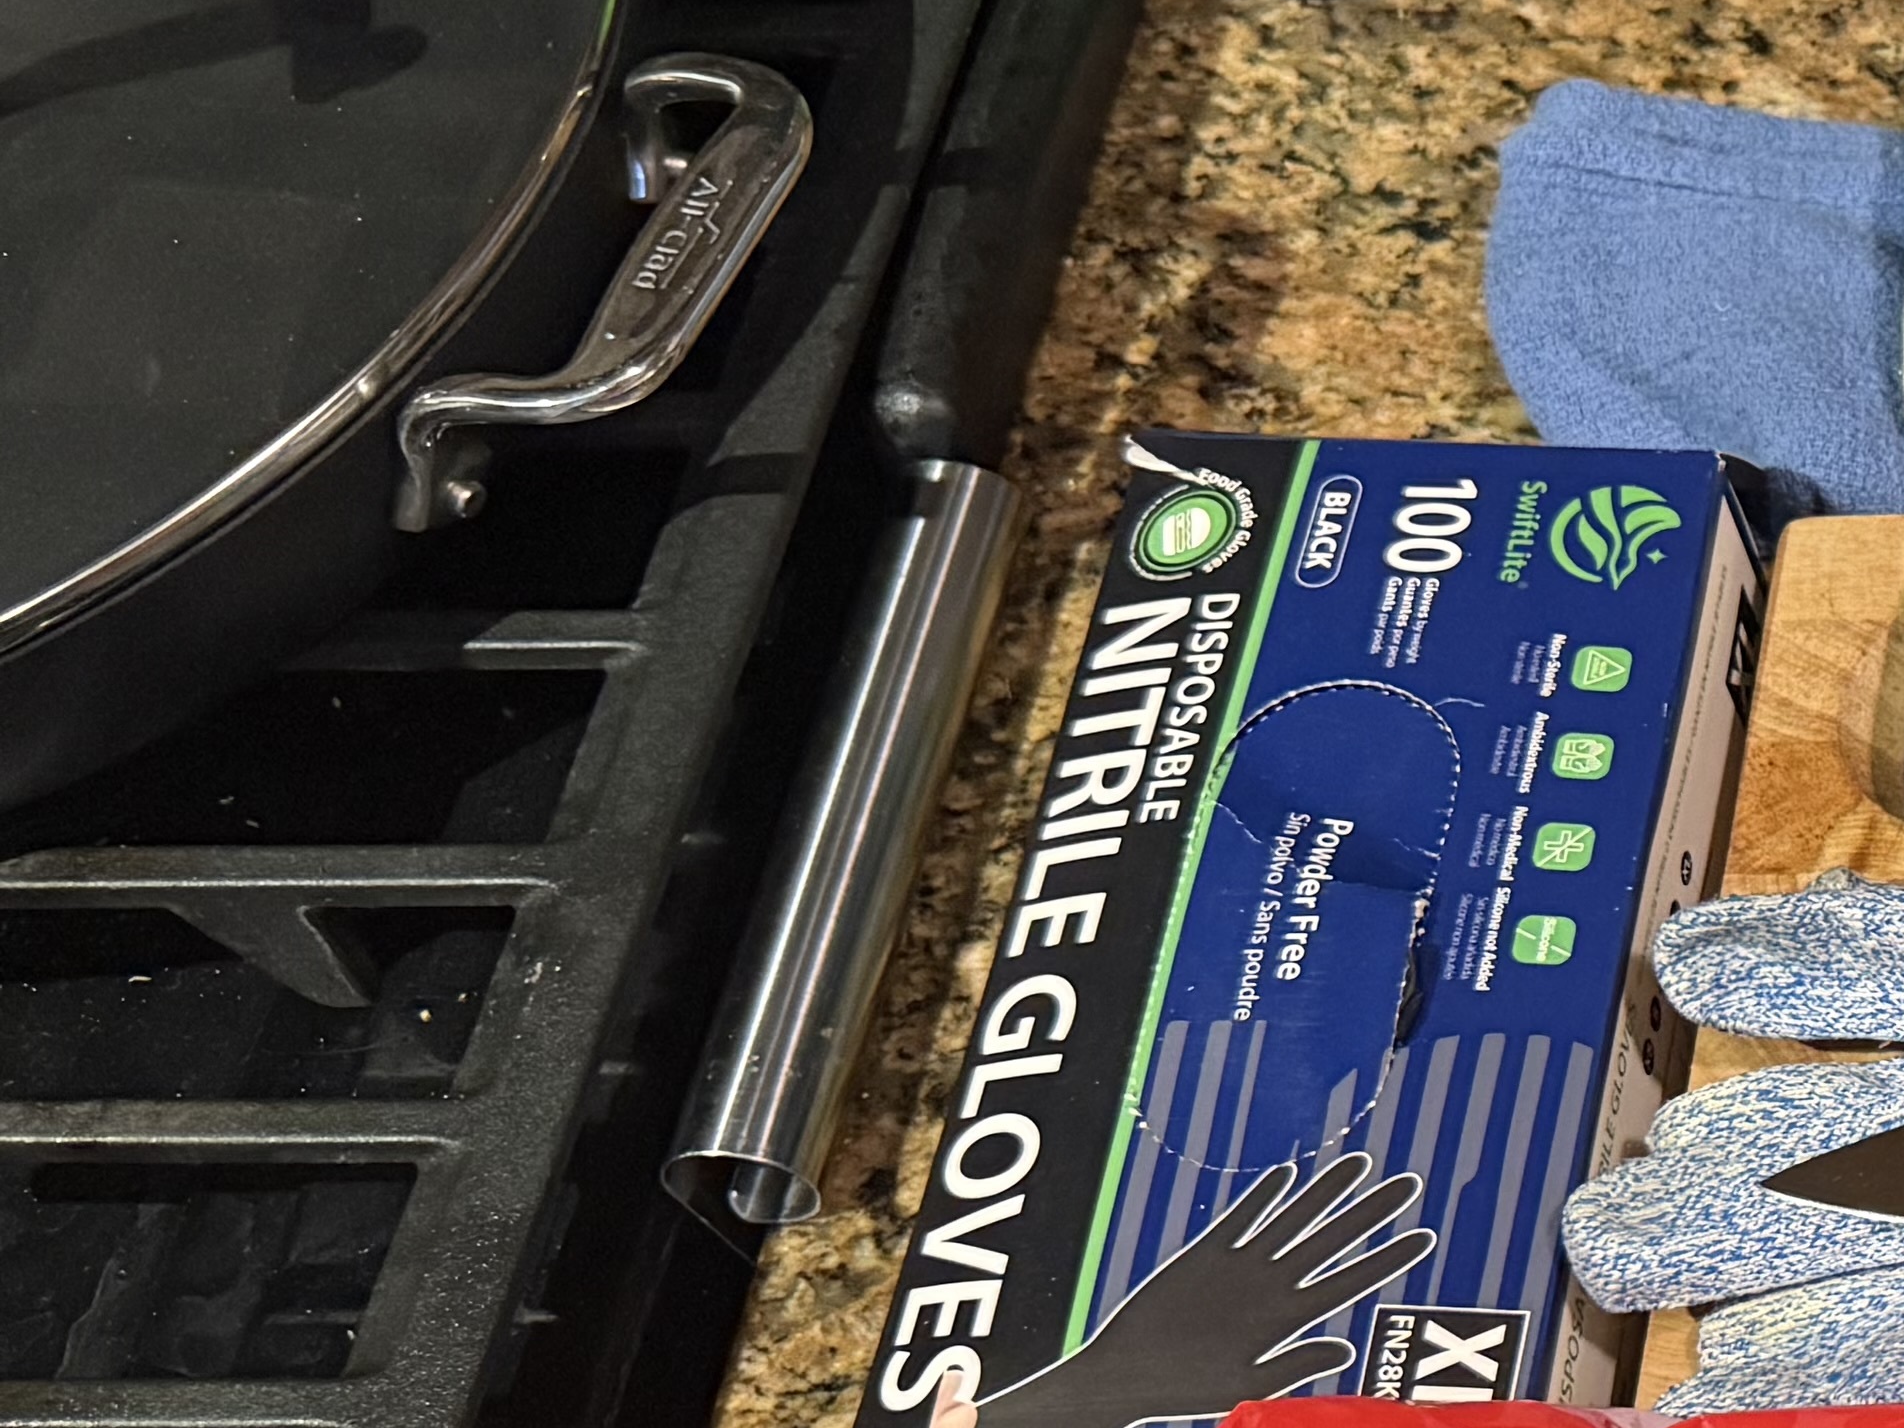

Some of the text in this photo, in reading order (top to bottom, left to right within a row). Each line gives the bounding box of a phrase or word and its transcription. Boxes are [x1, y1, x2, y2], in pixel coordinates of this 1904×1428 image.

[632, 177, 718, 289] All-Clad
[1302, 490, 1351, 570] BLACK
[1383, 478, 1478, 573] 100
[1500, 481, 1548, 584] SwiftLite
[1539, 633, 1567, 697] Non-Sterile
[1138, 591, 1240, 826] DISPOSABLE
[1519, 711, 1550, 794] Ambidextrous
[1266, 836, 1296, 885] polvo
[1283, 812, 1311, 835] Sin
[1497, 805, 1529, 882] Non-Medical
[1251, 900, 1281, 944] Sans
[1276, 818, 1355, 980] Powder Free
[879, 596, 1193, 1414] NITRILE GLOVES
[1233, 949, 1264, 1021] poudre
